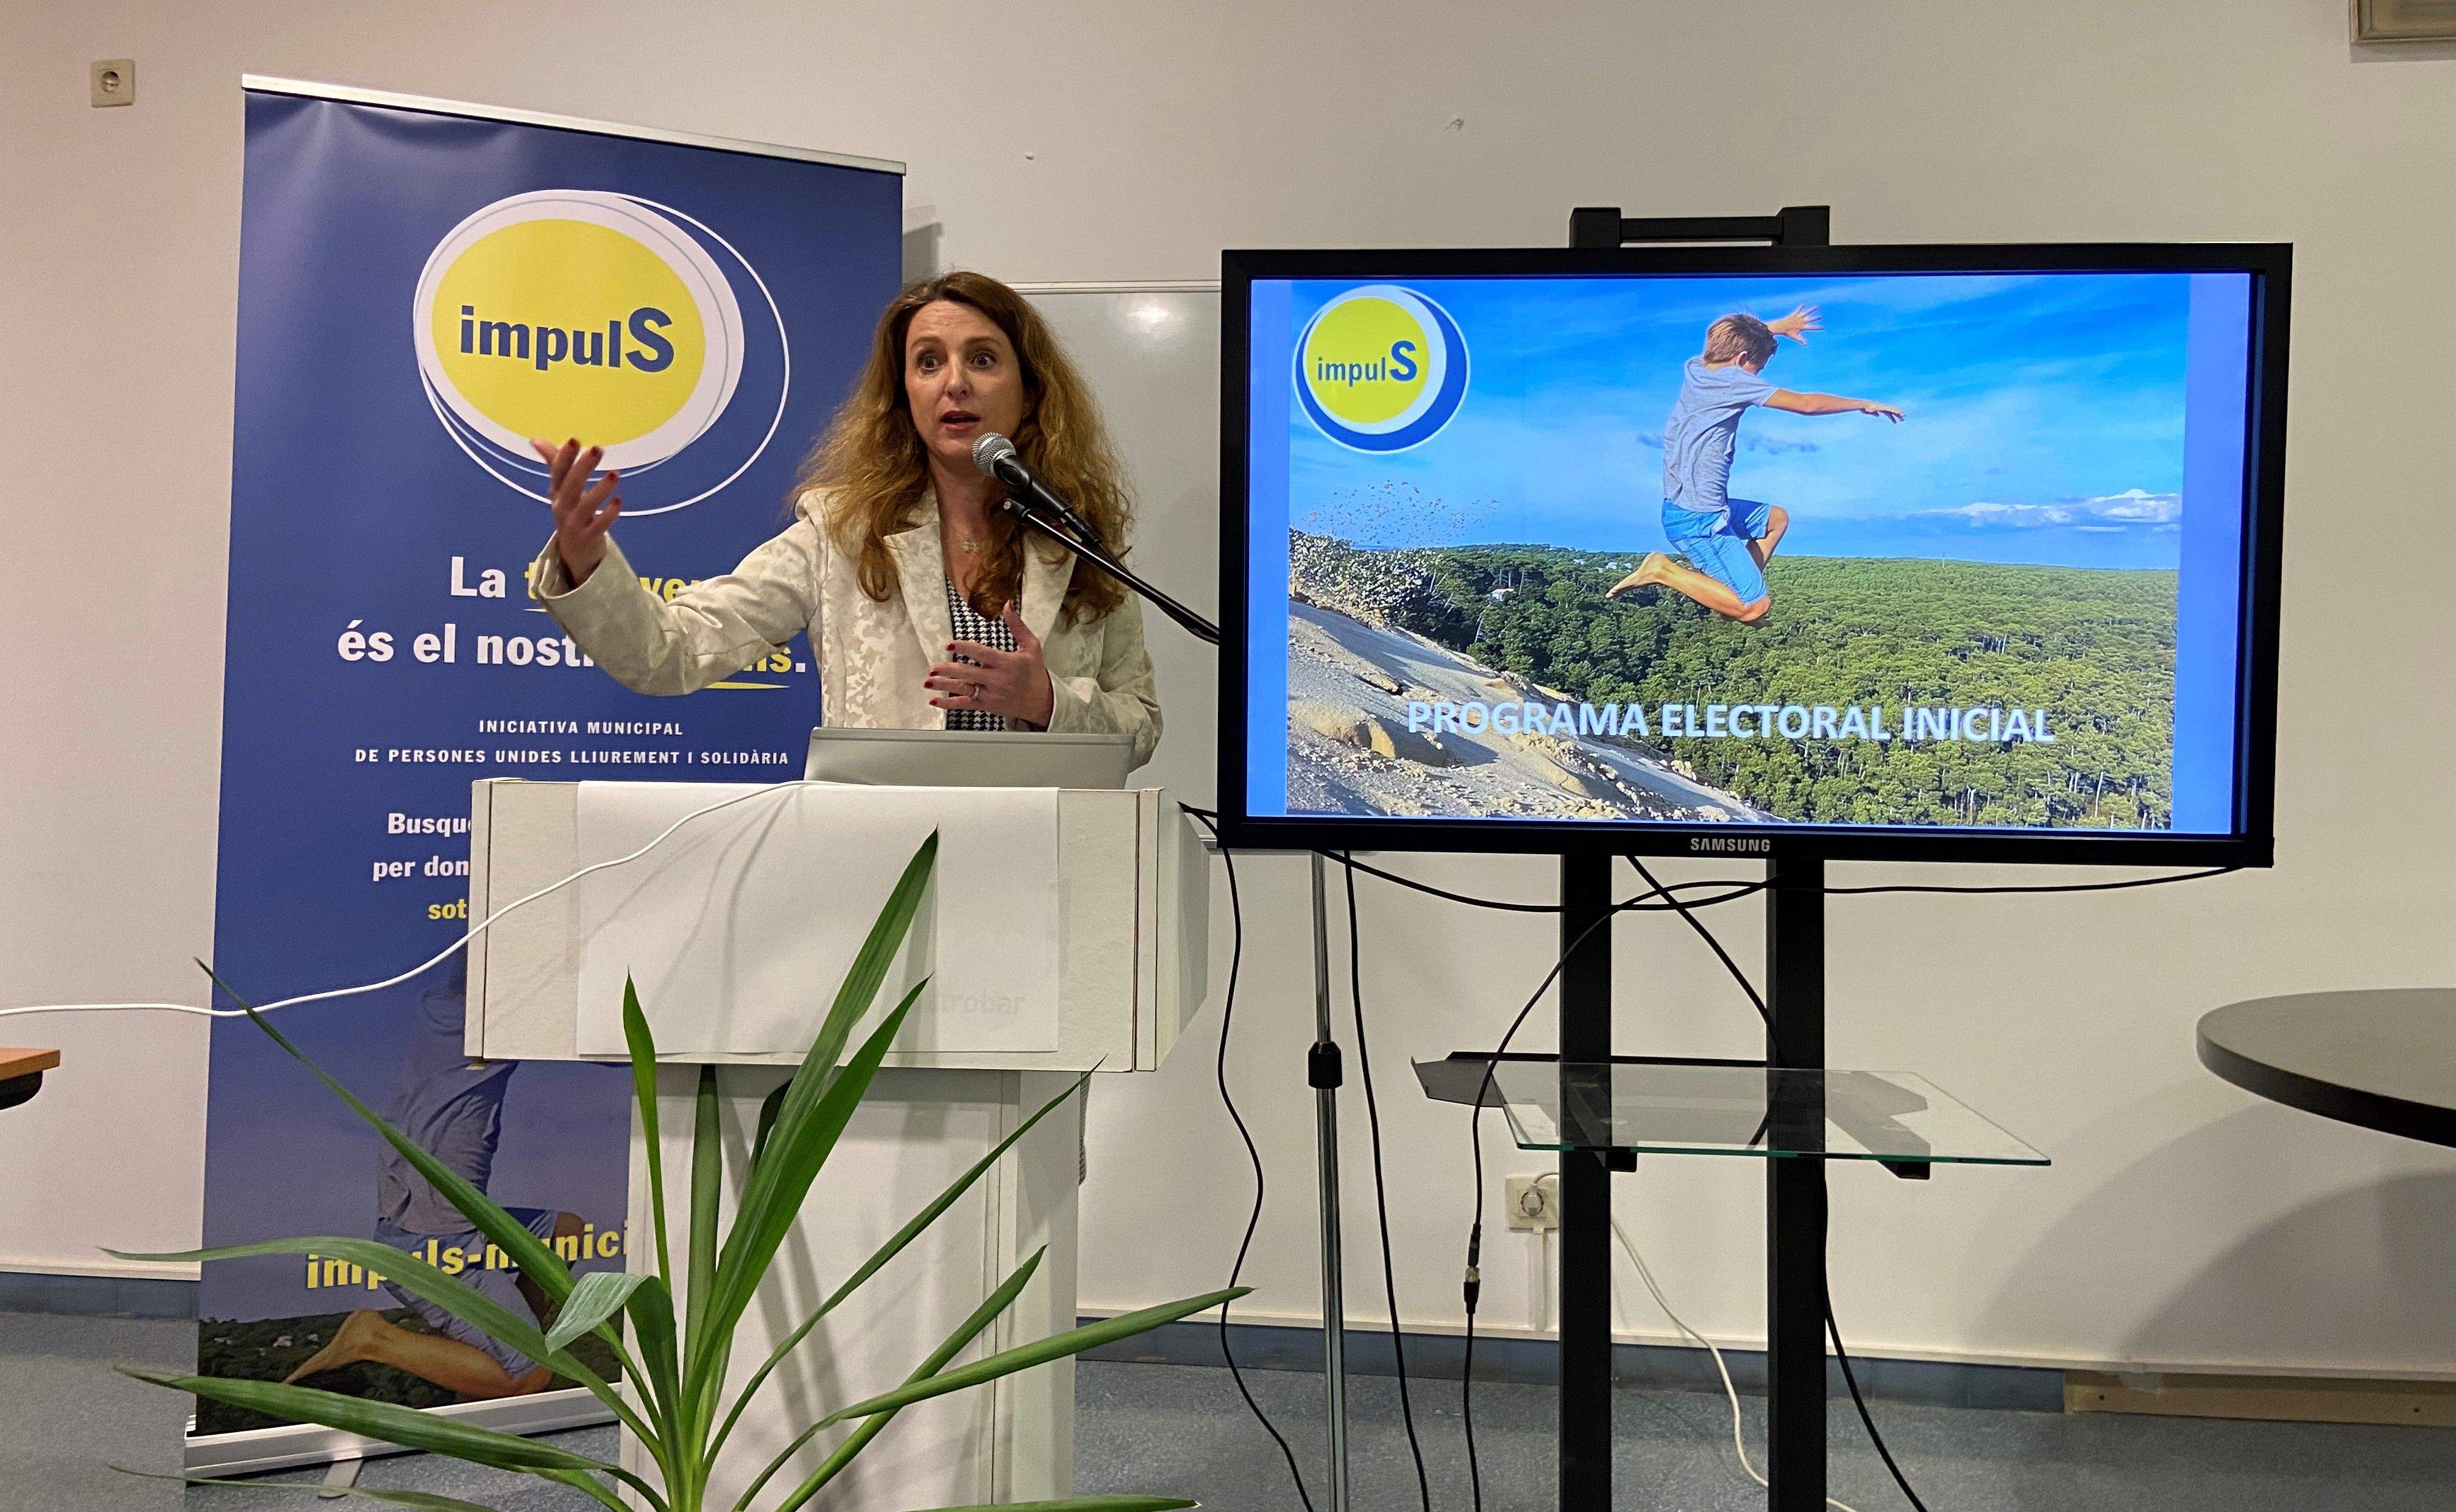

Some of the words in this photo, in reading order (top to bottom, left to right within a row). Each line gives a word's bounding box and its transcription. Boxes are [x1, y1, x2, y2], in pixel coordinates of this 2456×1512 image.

[460, 305, 674, 373] impulS
[1317, 340, 1418, 387] impulS
[450, 556, 506, 599] La
[338, 619, 395, 663] és
[412, 623, 456, 664] el
[476, 634, 595, 668] nost
[478, 719, 579, 735] INICIATIVA
[587, 720, 684, 736] MUNICIPAL
[1407, 701, 1649, 737] PROGRAMA
[1662, 704, 1891, 741] ELECTORAL
[1903, 707, 2056, 742] INICIAL
[355, 749, 380, 763] DE
[388, 749, 486, 764] PERSONES
[495, 749, 562, 765] UNIDES
[570, 750, 681, 765] LLIUREMENT
[687, 751, 693, 765] I
[700, 747, 788, 765] SOLIDÀRIA
[388, 812, 471, 838] Busqu
[1690, 837, 1771, 852] SAMSUNG
[372, 861, 416, 882] per
[428, 899, 467, 920] sot
